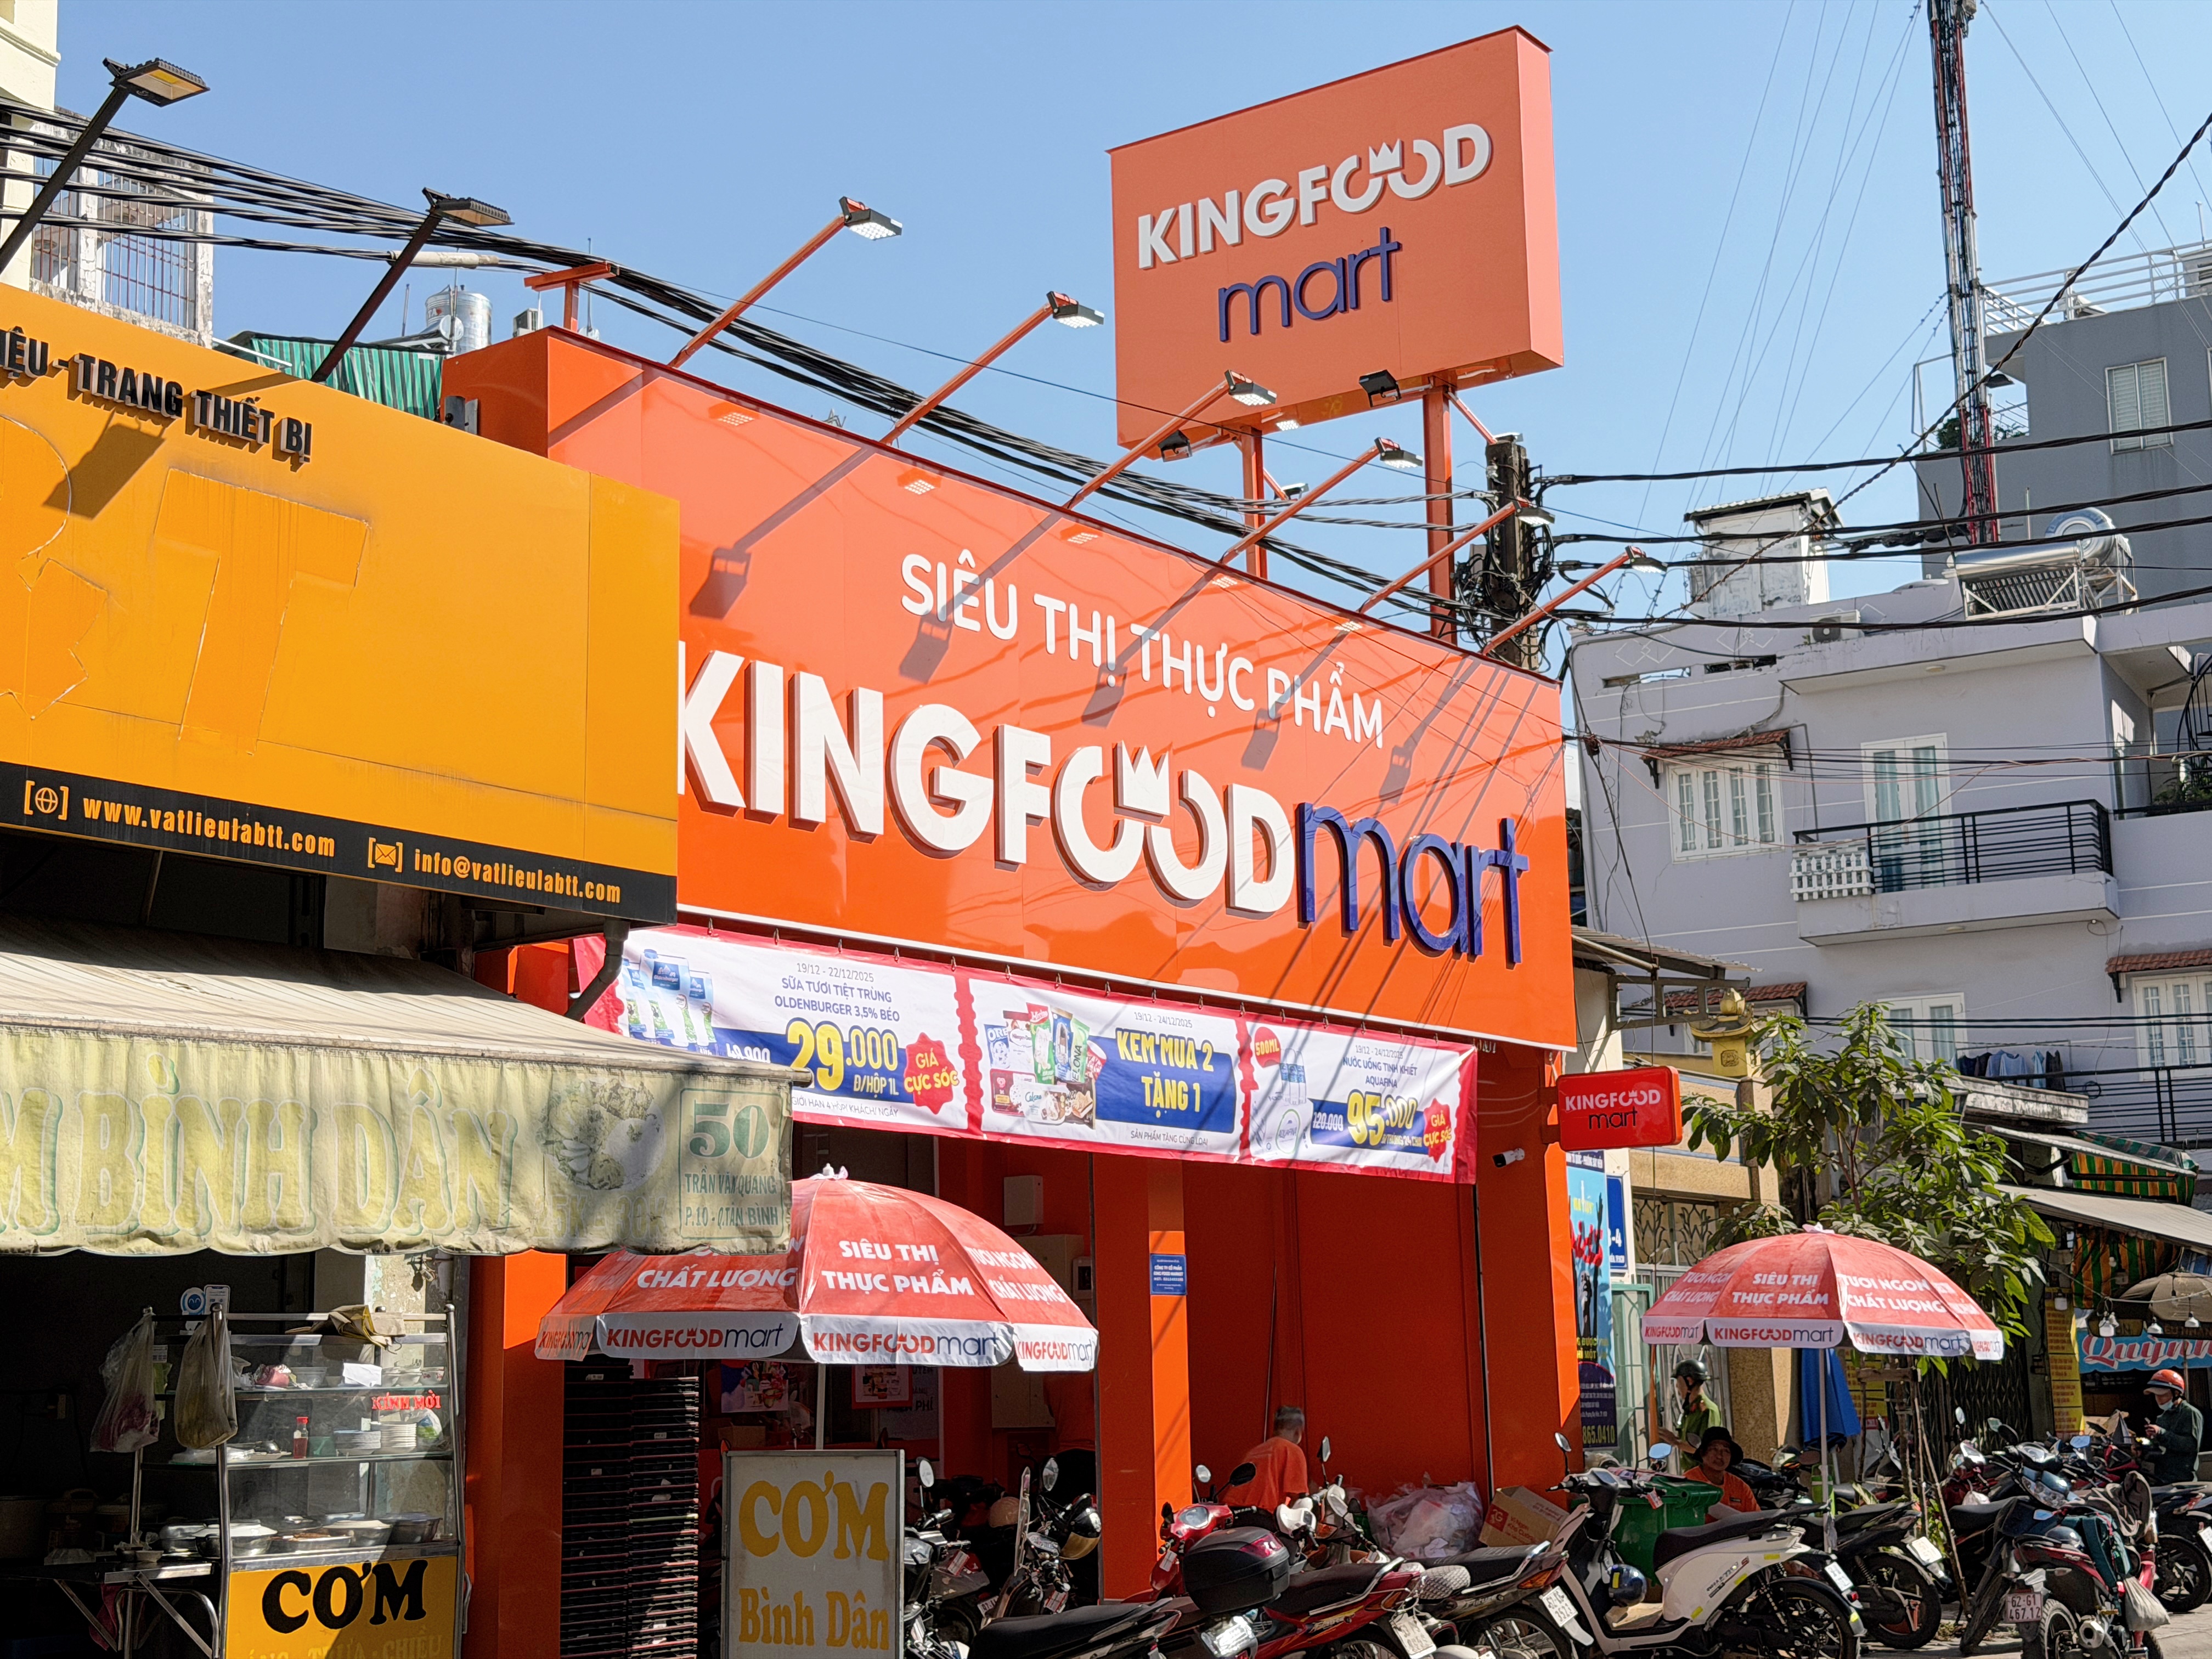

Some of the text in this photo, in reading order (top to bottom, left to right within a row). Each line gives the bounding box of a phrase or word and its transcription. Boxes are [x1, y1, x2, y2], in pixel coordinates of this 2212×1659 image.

[1138, 123, 1492, 269] KINGFOOD
[1218, 226, 1402, 342] mart
[73, 353, 183, 419] TRANG
[191, 388, 275, 445] THIẾT
[280, 417, 312, 464] BỊ
[900, 549, 1384, 749] SIÊU THỊ THỰC PHẨM
[414, 847, 622, 904] info@vatlieulabtt.com
[797, 963, 820, 975] 19/12
[828, 967, 874, 982] 22/12/2025
[782, 975, 891, 1003] SỮA TƯƠI TIỆT TRÙNG
[775, 995, 900, 1022] OLDENBURGER 3,5% BÉO
[1134, 1012, 1152, 1023] 19/12
[1158, 1015, 1193, 1028] 24/12/2025
[787, 1020, 899, 1091] 29.000
[915, 1047, 939, 1068] GIÁ
[1116, 1030, 1214, 1072] KEM MUA 2
[1255, 1039, 1280, 1056] 500ML
[1356, 1045, 1370, 1054] 19/12
[1344, 1056, 1418, 1076] NƯỚC UỐNG TINH KHIẾT
[854, 1072, 899, 1098] Đ/HỘP 1L
[904, 1066, 959, 1095] CỰC SỐC
[1365, 1075, 1398, 1088] AQUAFINA
[1141, 1070, 1200, 1118] TẶNG 1
[1565, 1089, 1661, 1111] KINGFOOD
[689, 1098, 770, 1159] 50
[1347, 1092, 1418, 1146] 95.000
[1430, 1110, 1446, 1127] GIÁ
[1588, 1105, 1638, 1130] mart
[75, 1052, 317, 1235] BÌNH
[331, 1067, 518, 1235] DÂN
[1423, 1130, 1439, 1148] CỰC
[684, 1169, 714, 1194] TRẦN
[738, 1174, 777, 1198] QUANG
[685, 1206, 708, 1227] P.10
[748, 1202, 778, 1226] BÌNH
[838, 1238, 939, 1265] SIÊU THỊ
[637, 1264, 706, 1288] CHẤT
[706, 1267, 798, 1290] LƯỢNG
[821, 1269, 975, 1296] THỰC PHẨM
[1752, 1271, 1818, 1287] SIÊU THỊ
[1878, 1278, 1930, 1291] NGON
[1732, 1291, 1775, 1306] THỰC
[1888, 1298, 1948, 1314] LƯỢNG
[607, 1322, 784, 1348] KINGFOODmart
[1714, 1327, 1834, 1342] KINGFOODmart
[371, 1389, 441, 1410] KÍNH MỜI
[738, 1470, 890, 1561] CƠM
[261, 1559, 428, 1634] CƠM
[2011, 1594, 2036, 1607] 62-G1
[738, 1586, 890, 1650] Bình Dân
[2009, 1606, 2041, 1620] 467.12
